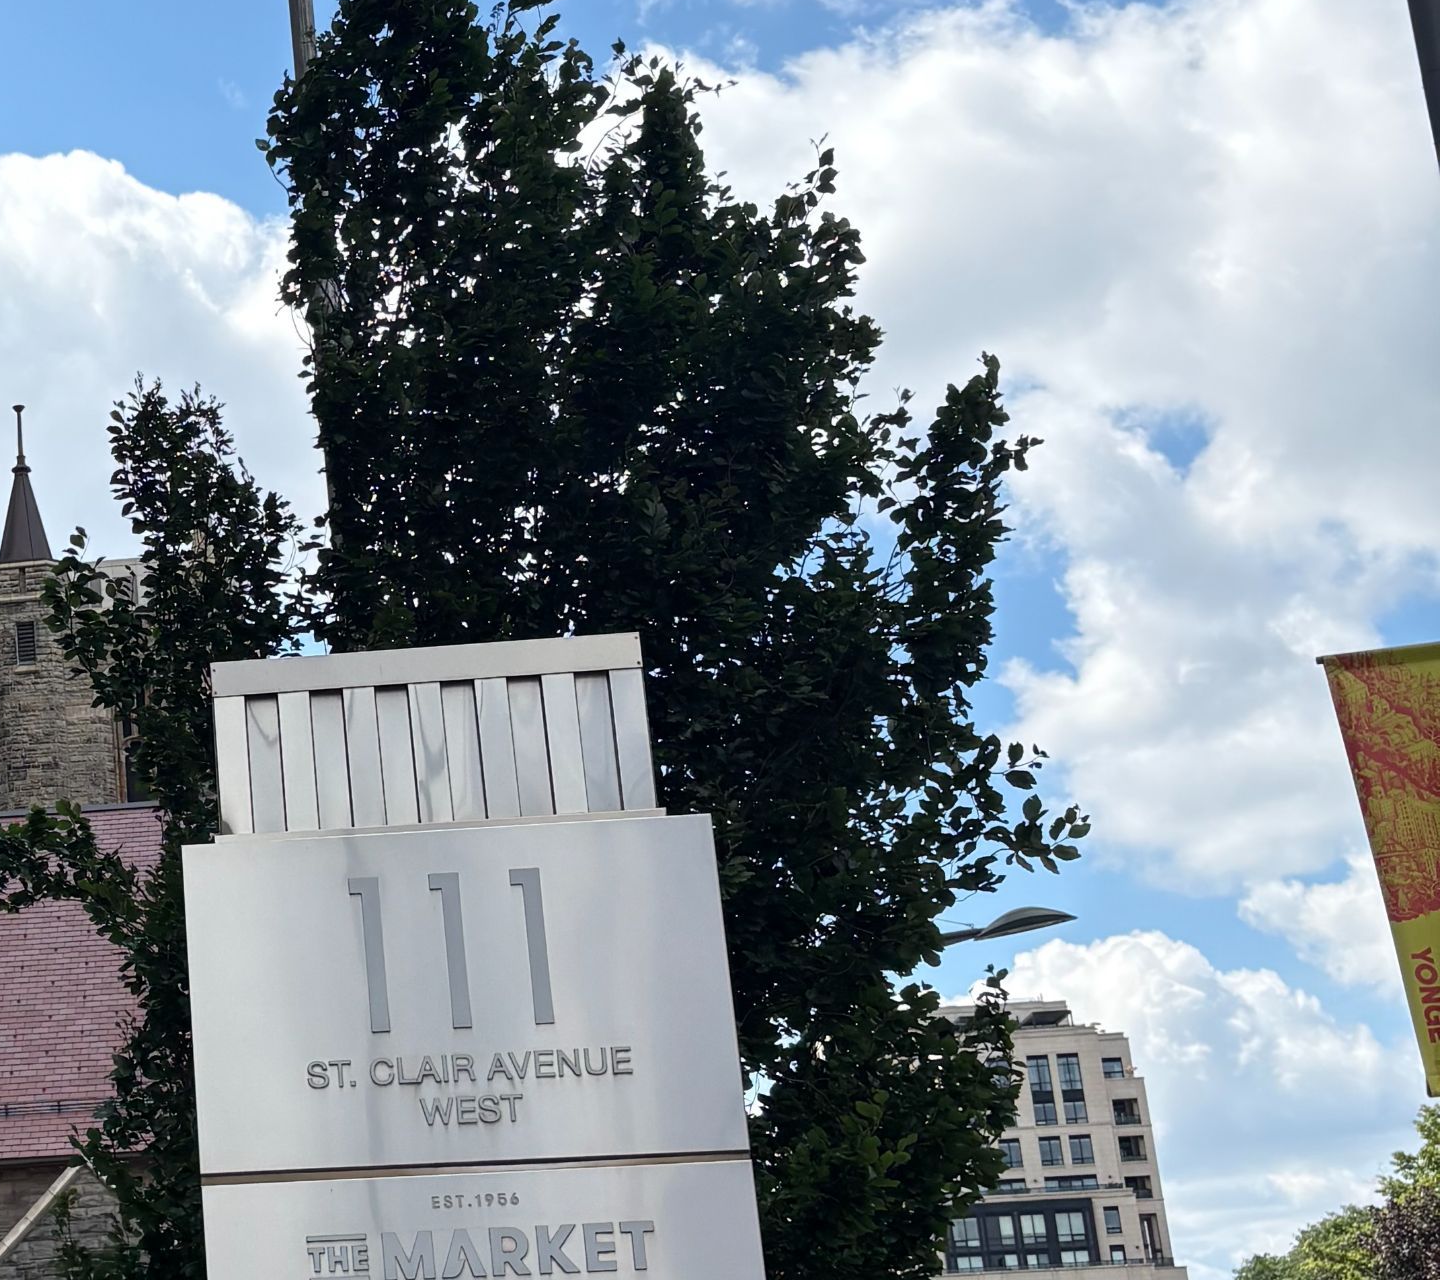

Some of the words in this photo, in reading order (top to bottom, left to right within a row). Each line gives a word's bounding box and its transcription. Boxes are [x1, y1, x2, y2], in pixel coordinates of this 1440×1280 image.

[347, 867, 556, 1034] 111
[306, 1059, 357, 1089] ST.
[369, 1053, 477, 1087] CLAIR
[486, 1046, 635, 1082] AVENUE
[419, 1093, 524, 1126] WEST
[306, 1242, 371, 1274] THE
